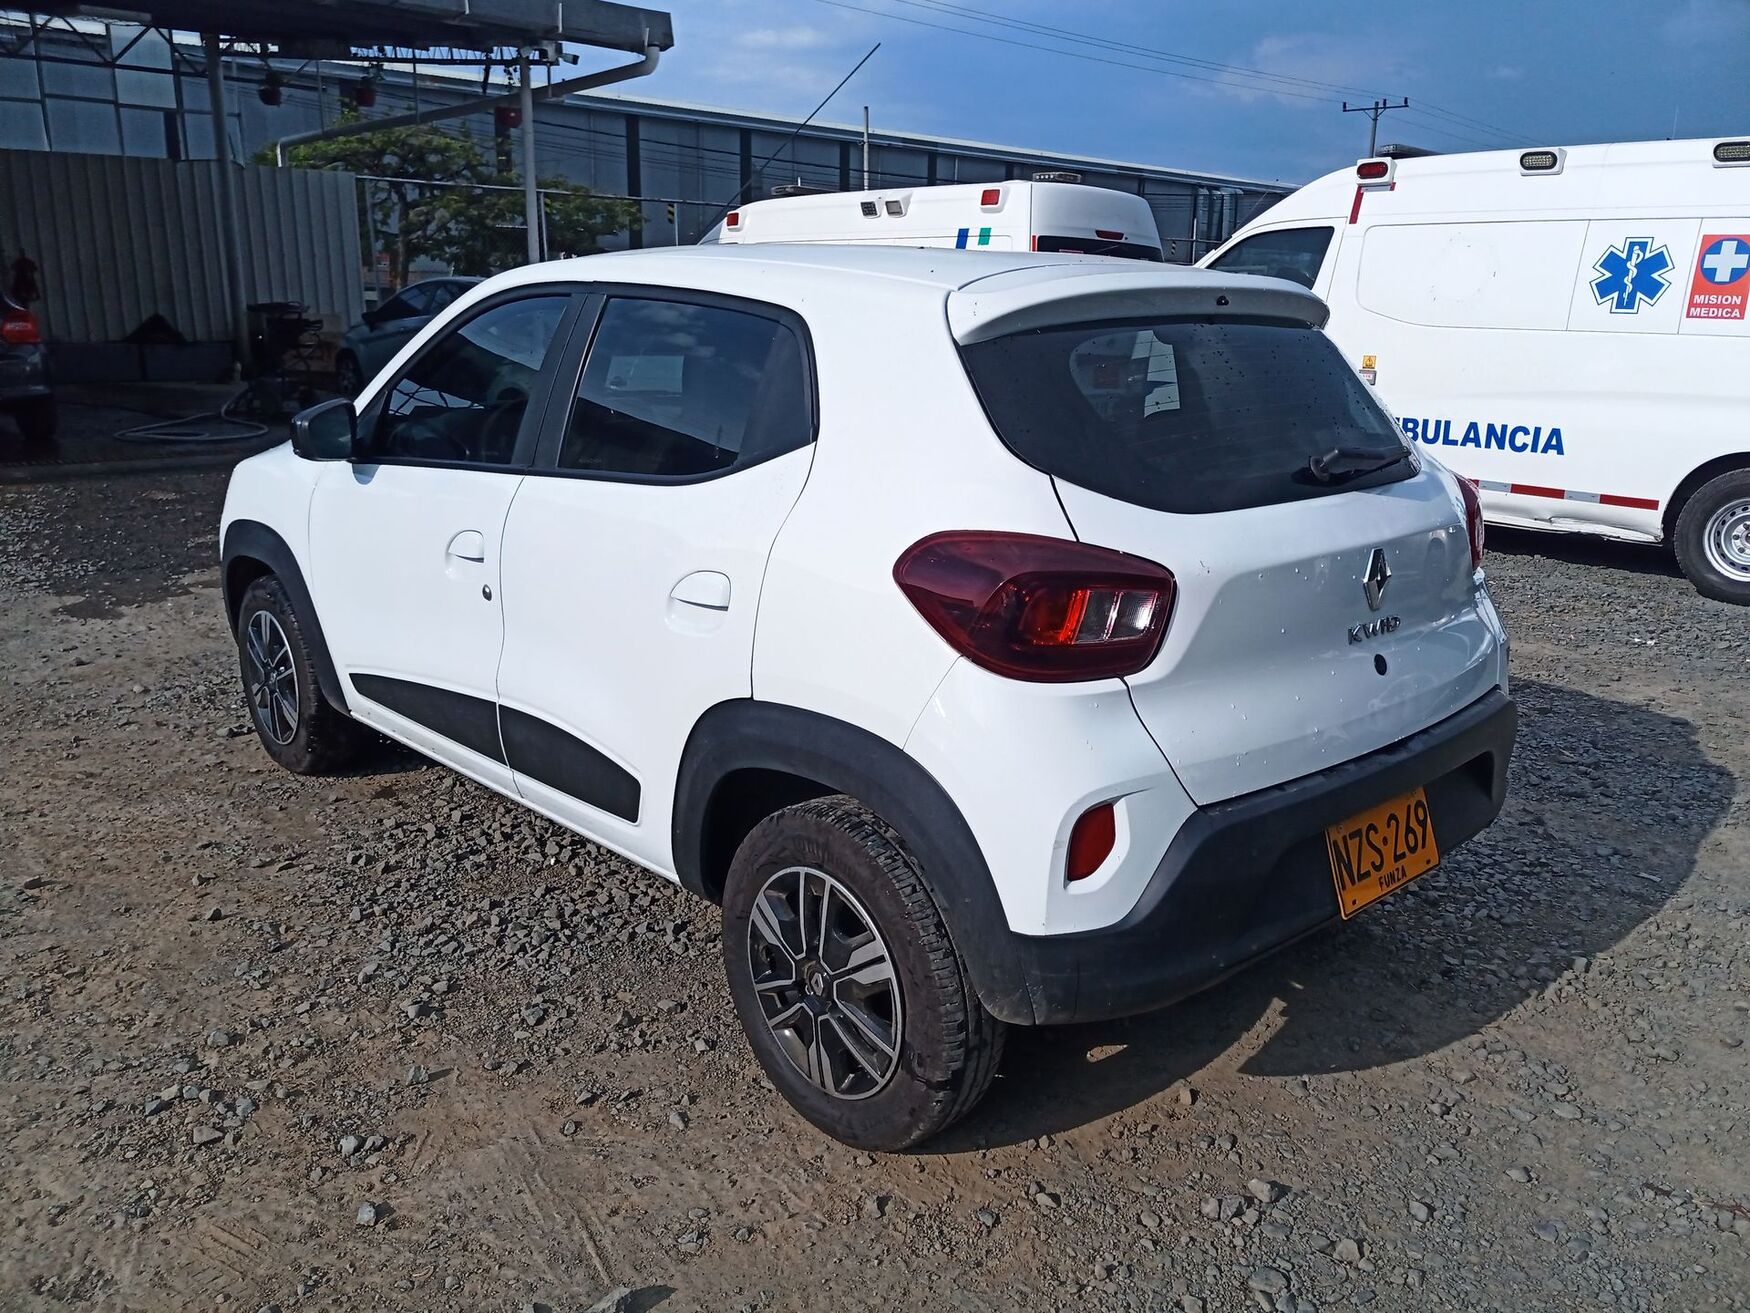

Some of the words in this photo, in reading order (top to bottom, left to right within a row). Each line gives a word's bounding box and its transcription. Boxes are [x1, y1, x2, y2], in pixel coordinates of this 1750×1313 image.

[1689, 307, 1741, 318] MEDICA
[1693, 294, 1742, 305] MISION
[1395, 417, 1565, 456] BULANCIA
[1347, 615, 1401, 645] KWID
[1378, 864, 1408, 891] FUNZA
